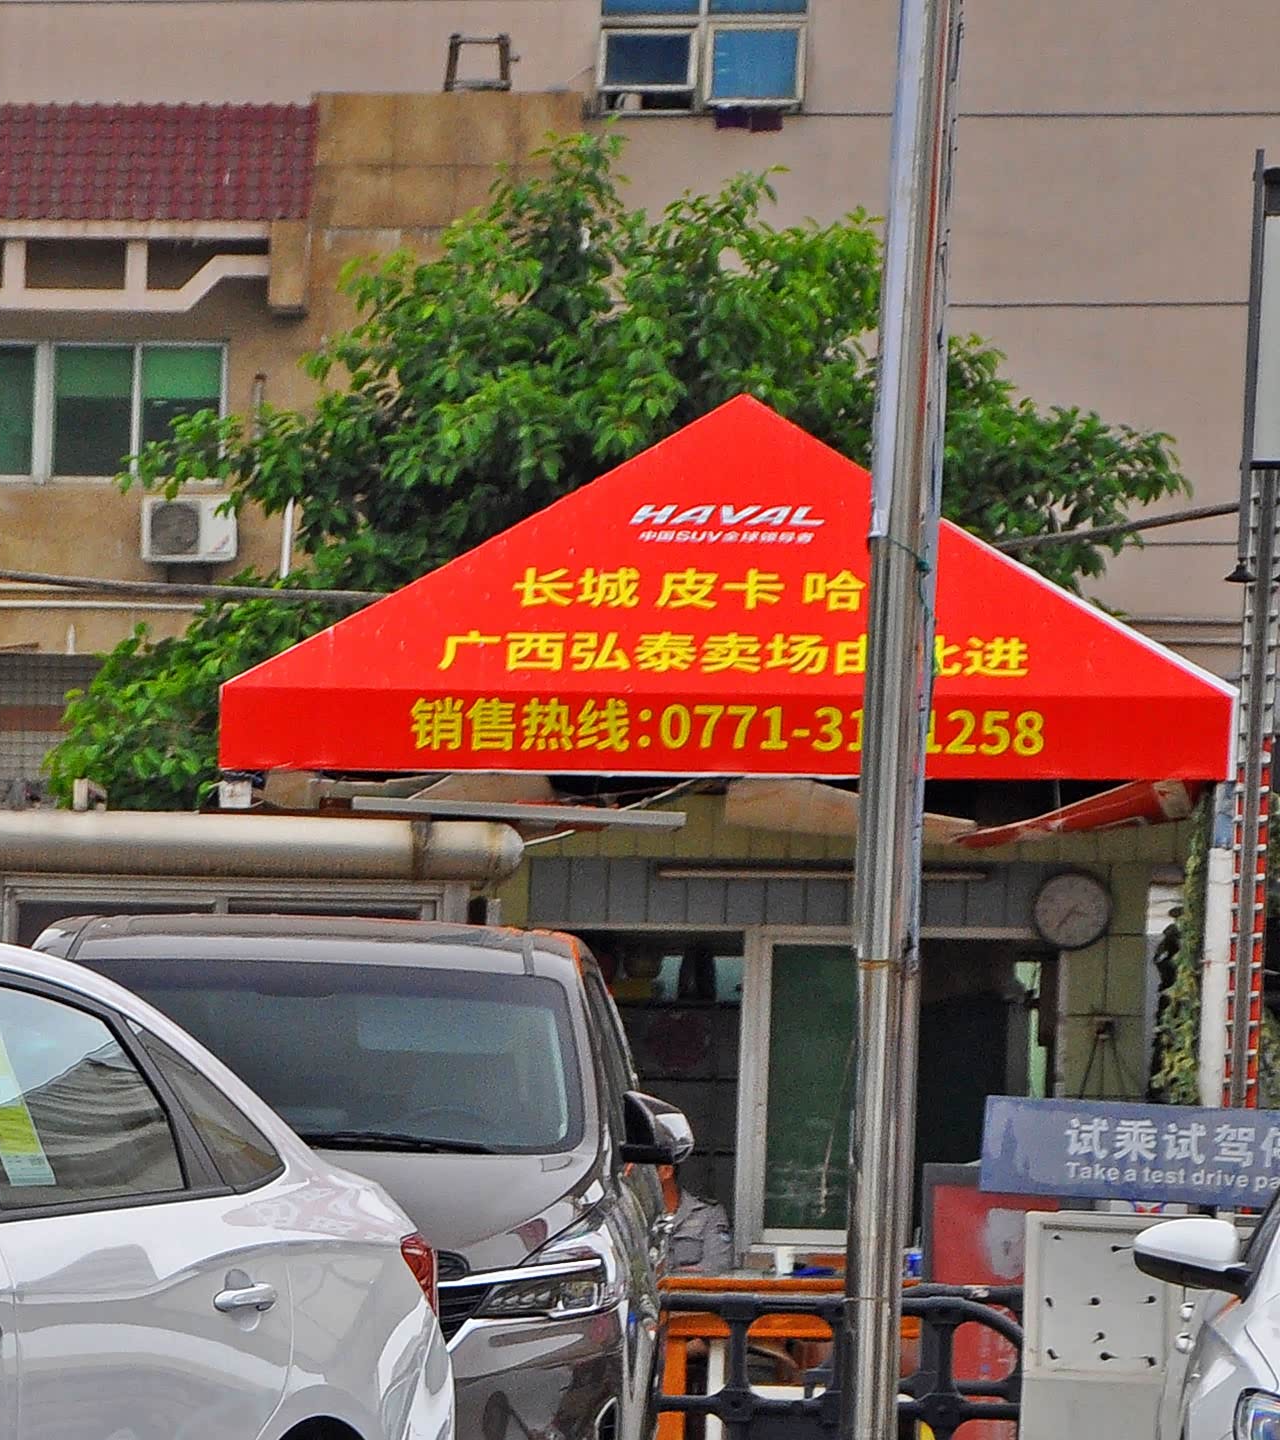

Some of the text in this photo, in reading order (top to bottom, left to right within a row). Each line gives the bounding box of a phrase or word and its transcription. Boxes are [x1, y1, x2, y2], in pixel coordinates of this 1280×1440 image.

[629, 504, 826, 527] HAVAL
[513, 567, 641, 609] 长城
[654, 568, 785, 611] 皮卡
[1066, 1161, 1120, 1181] Take
[1123, 1168, 1137, 1182] a
[1143, 1166, 1186, 1185] test
[1192, 1168, 1249, 1188] drive
